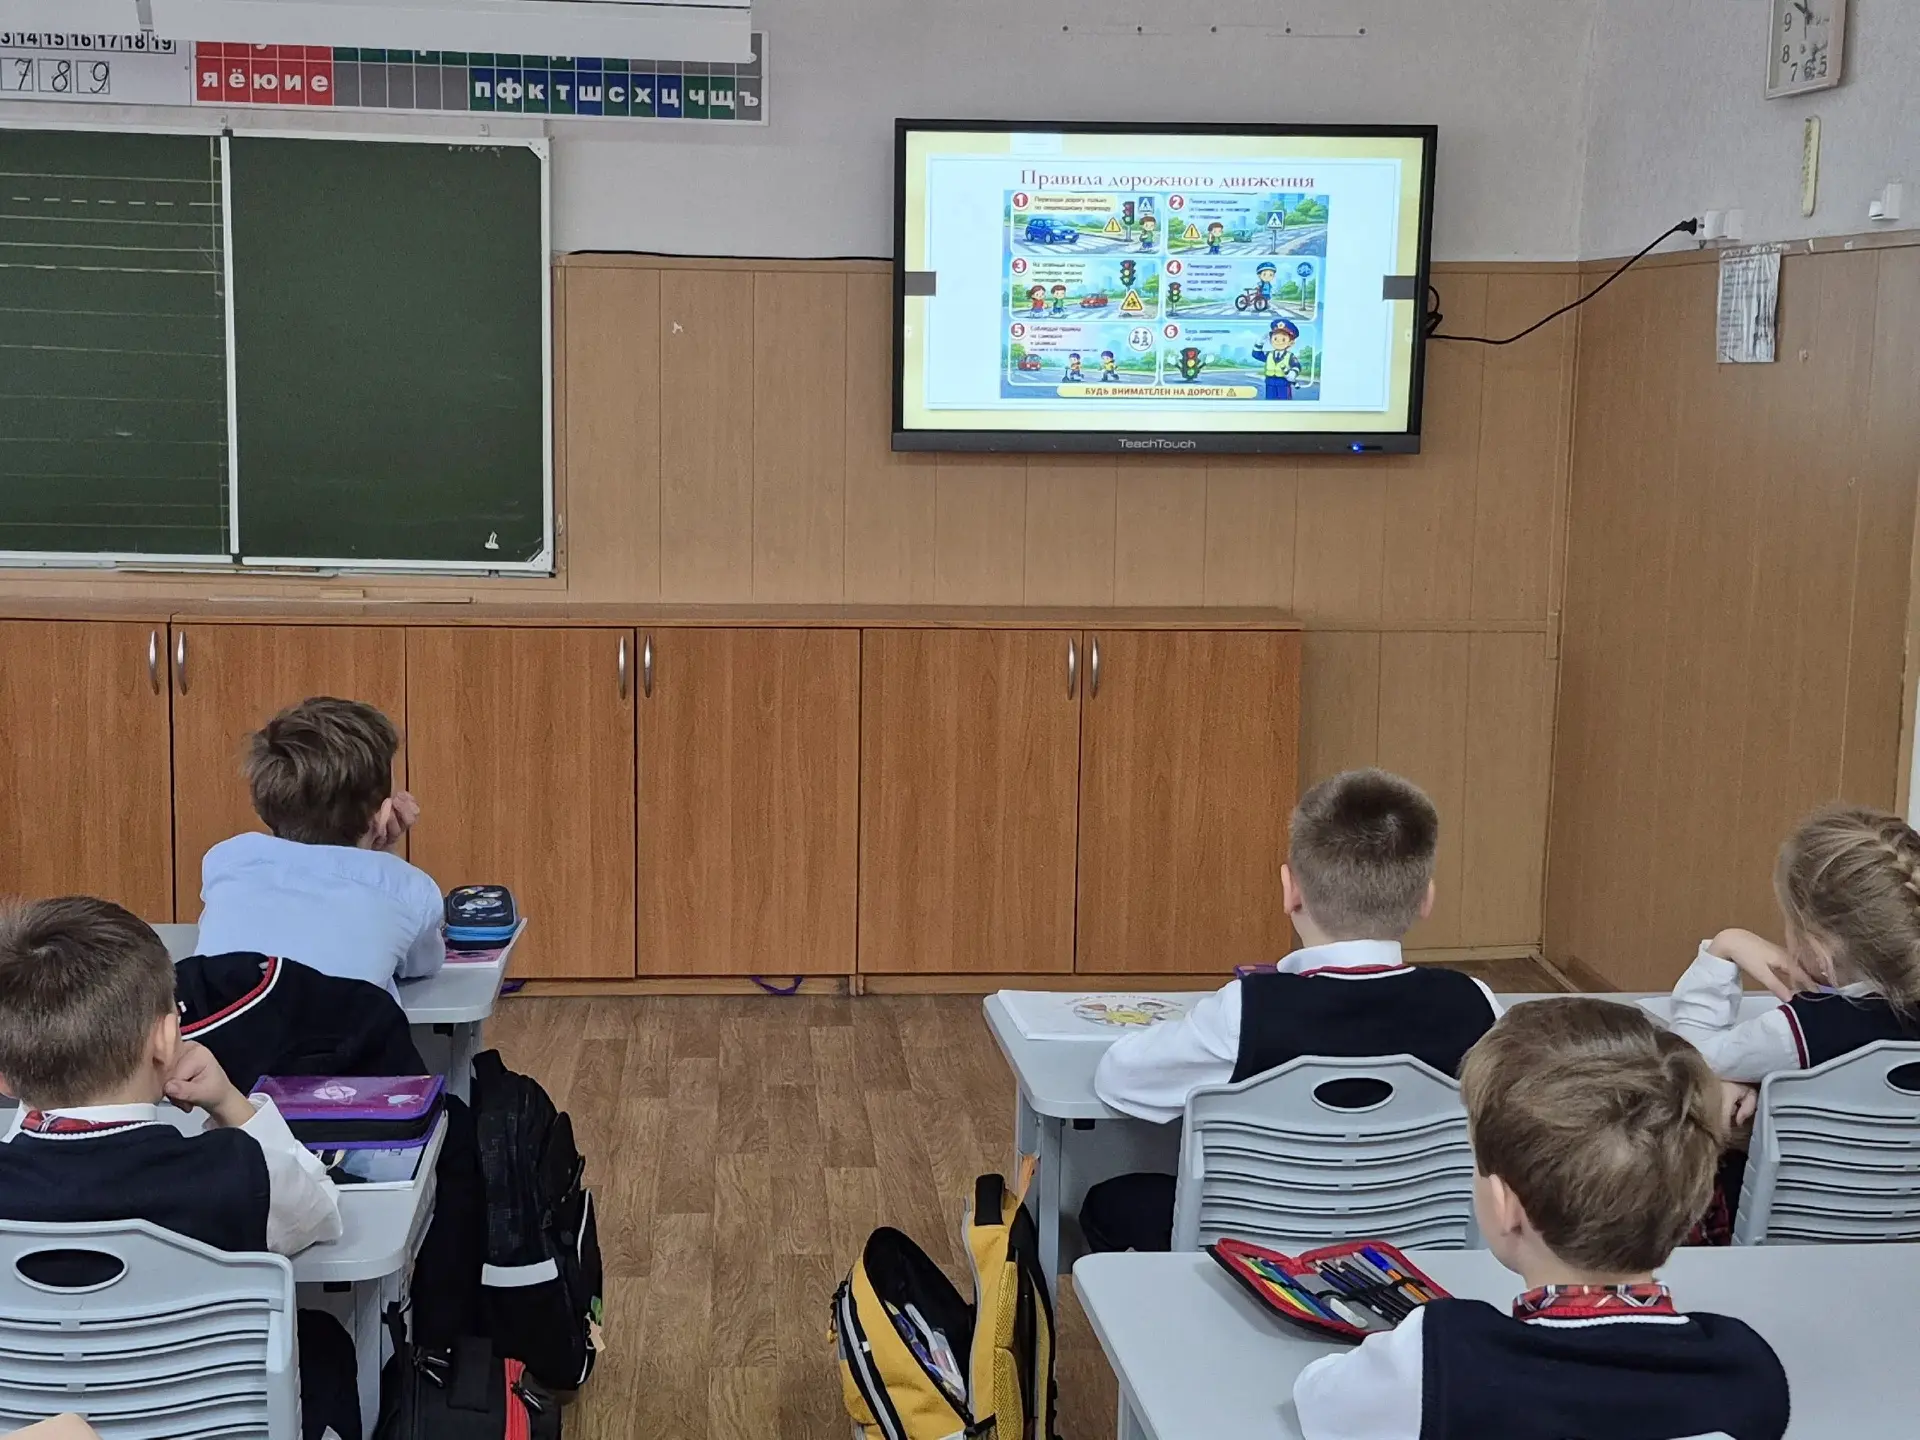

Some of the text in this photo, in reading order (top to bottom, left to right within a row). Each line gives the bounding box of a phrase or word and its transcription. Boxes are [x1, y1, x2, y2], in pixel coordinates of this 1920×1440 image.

[16, 33, 38, 44] 14
[44, 34, 65, 46] 15
[71, 34, 92, 47] 16
[98, 34, 118, 48] 17
[124, 35, 145, 49] 18
[14, 58, 109, 93] 7 8 9
[1021, 169, 1316, 191] Правила дорожного движения
[1085, 387, 1224, 397] БУДЬ ВНИМАТЕЛЕН НА ДОРОГЕ!
[1118, 438, 1196, 449] TeachTouch
